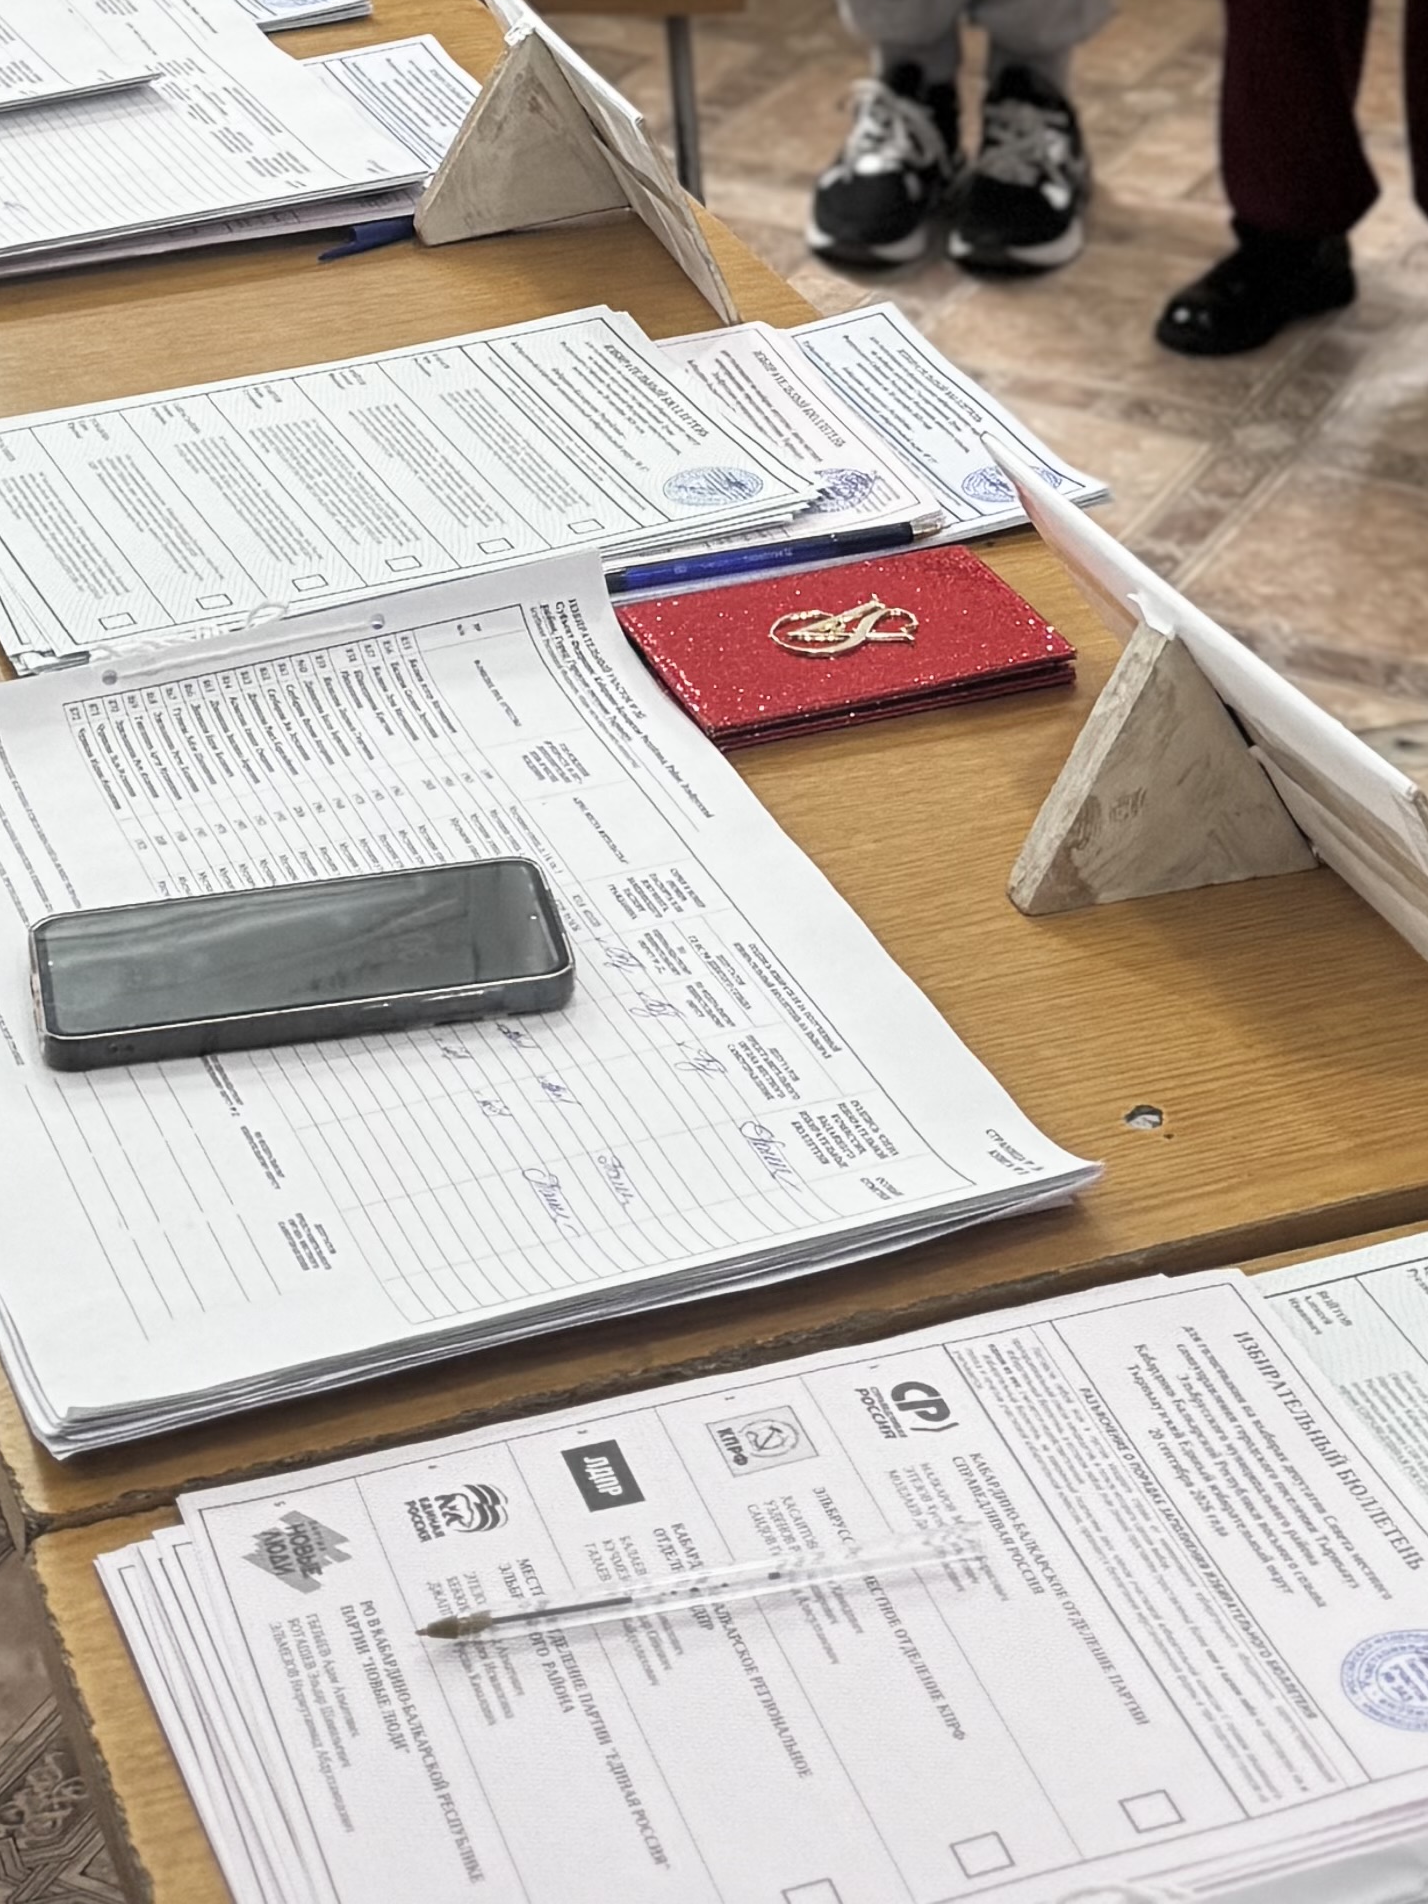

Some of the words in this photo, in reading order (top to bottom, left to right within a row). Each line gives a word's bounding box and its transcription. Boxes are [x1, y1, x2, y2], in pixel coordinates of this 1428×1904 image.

[715, 1427, 750, 1466] КПРФ
[853, 1387, 897, 1440] РОССИЯ
[1230, 1330, 1351, 1468] ИЗБИРАТЕЛЬНЫЙ
[1335, 1468, 1428, 1571] БЮЛЛЕТЕНЬ
[580, 1453, 624, 1499] ЛДПР
[258, 1527, 295, 1576] ЛЮДИ
[283, 1522, 323, 1579] НОВЫЕ
[403, 1500, 432, 1543] РОССИЯ
[416, 1496, 446, 1539] ЕДИНАЯ
[950, 1455, 1015, 1547] СПРАВЕДЛИВАЯ
[1005, 1546, 1045, 1594] РОССИЯ
[811, 1485, 865, 1562] ЭЛЬБРУСС
[890, 1627, 945, 1703] ОТДЕЛЕНИЕ
[934, 1703, 968, 1741] КПРФ
[967, 1452, 1069, 1600] КАБАРДИНО-БАЛКАРСКОЕ
[1058, 1600, 1117, 1674] ОТДЕЛЕНИЕ
[1106, 1674, 1150, 1726] ПАРТИИ
[338, 1604, 371, 1655] ПАРТИИ
[357, 1656, 393, 1708] "НОВЫЕ
[377, 1708, 411, 1756] ЛЮДИ"
[539, 1660, 577, 1714] РАЙОНА
[367, 1627, 450, 1792] КАБАРДИНО-БАЛКАРСКОЙ
[435, 1792, 486, 1884] РЕСПУБЛИКЕ
[544, 1625, 588, 1691] ТДЕЛЕНИЕ
[576, 1692, 612, 1745] ПАРТИИ
[600, 1747, 642, 1808] "ЕДИНАЯ
[629, 1808, 671, 1873] РОССИЯ"
[747, 1675, 812, 1779] РЕГИОНАЛЬНОЕ
